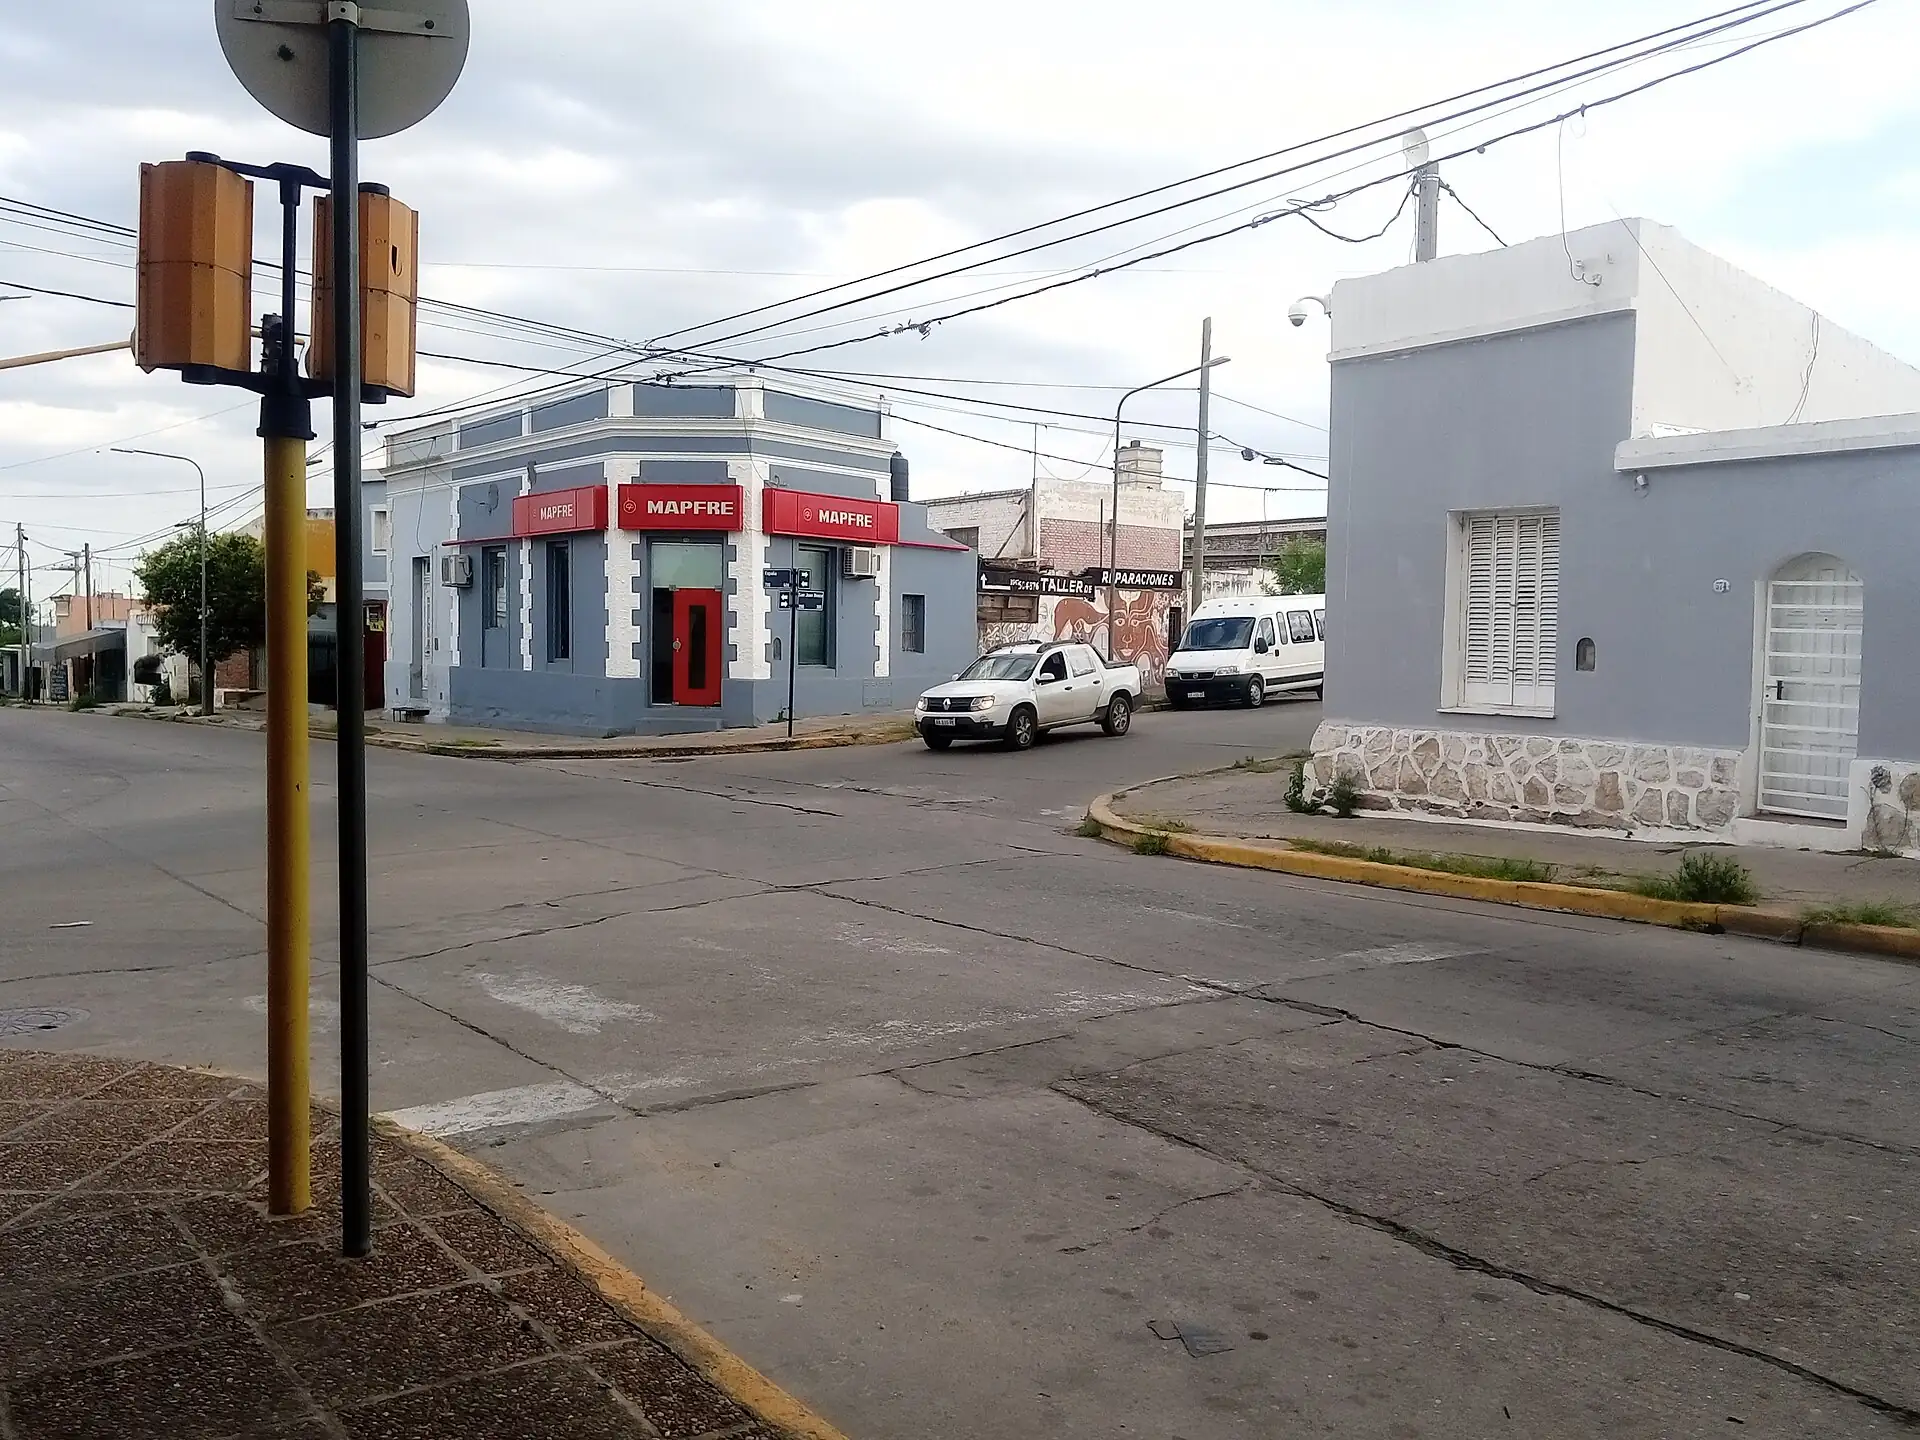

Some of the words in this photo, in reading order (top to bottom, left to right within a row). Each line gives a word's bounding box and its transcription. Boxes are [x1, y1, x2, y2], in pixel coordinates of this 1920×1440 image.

[540, 503, 573, 521] MAPFRE
[647, 500, 733, 515] MAPFRE
[818, 509, 873, 528] MAPFRE
[1040, 577, 1083, 594] TALLER
[1084, 584, 1093, 594] DE
